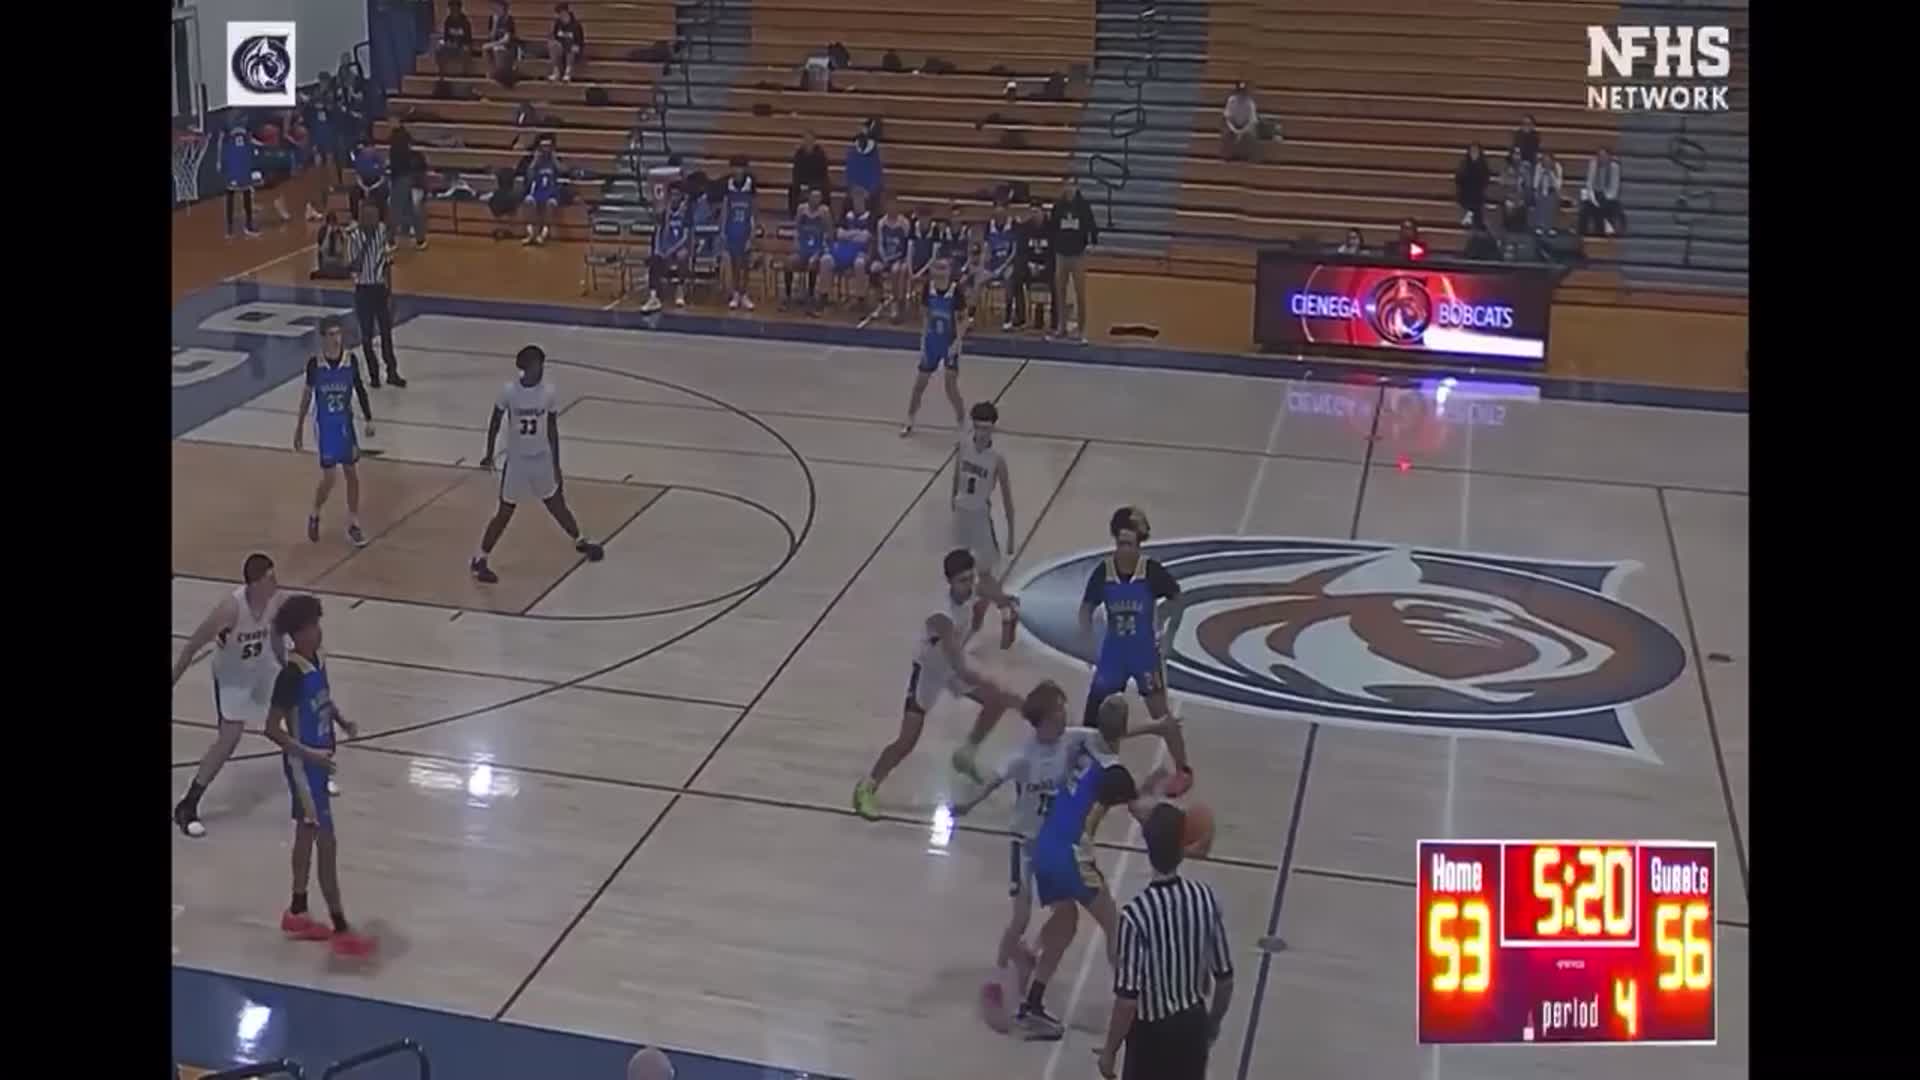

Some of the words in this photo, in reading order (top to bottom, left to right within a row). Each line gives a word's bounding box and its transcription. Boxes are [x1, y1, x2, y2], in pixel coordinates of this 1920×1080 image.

[1291, 294, 1361, 318] CIENEGA
[1438, 303, 1514, 329] BOBCATS
[520, 419, 537, 436] 33
